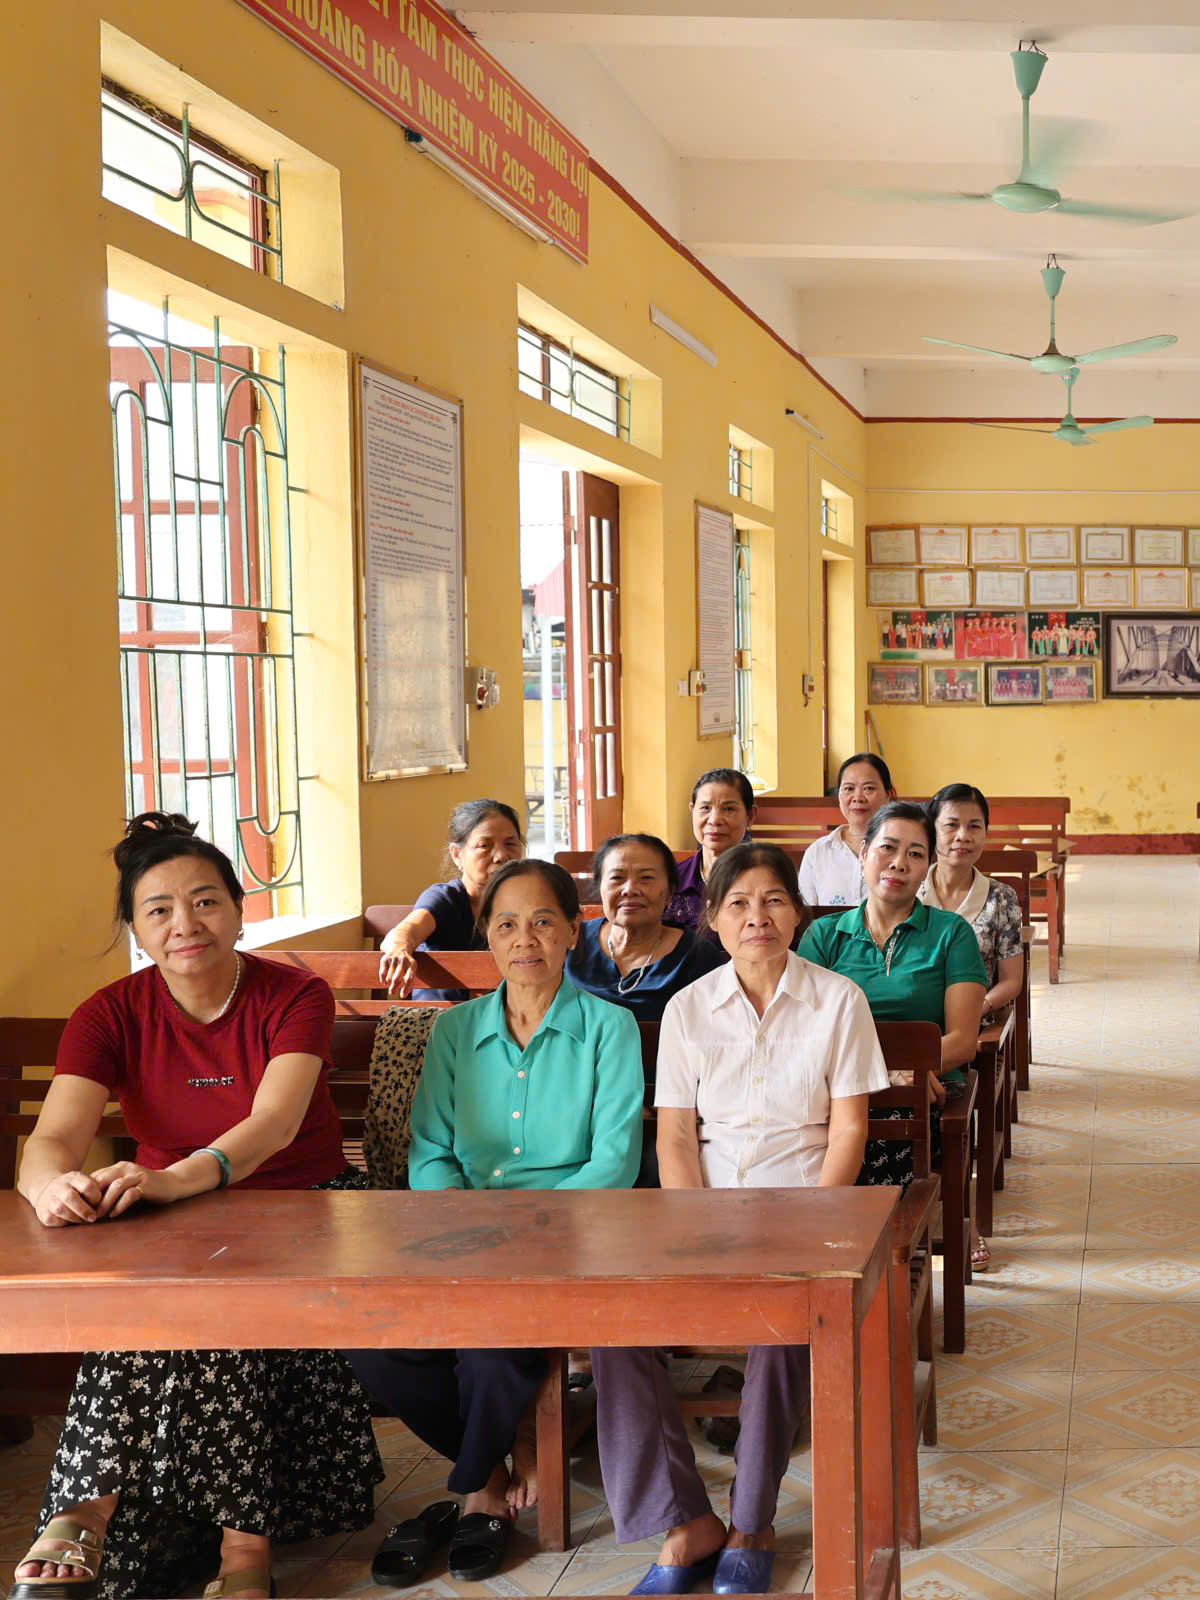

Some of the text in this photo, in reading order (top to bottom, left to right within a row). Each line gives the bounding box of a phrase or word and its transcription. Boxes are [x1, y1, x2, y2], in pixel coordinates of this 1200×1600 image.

[373, 40, 412, 107] HÓA
[418, 77, 474, 157] NHIỆM
[479, 128, 497, 175] KỲ
[502, 150, 536, 205] 2025
[547, 189, 580, 242] 2030!
[400, 0, 588, 199] TÂM THỰC HIỆN THẮNG LỢI
